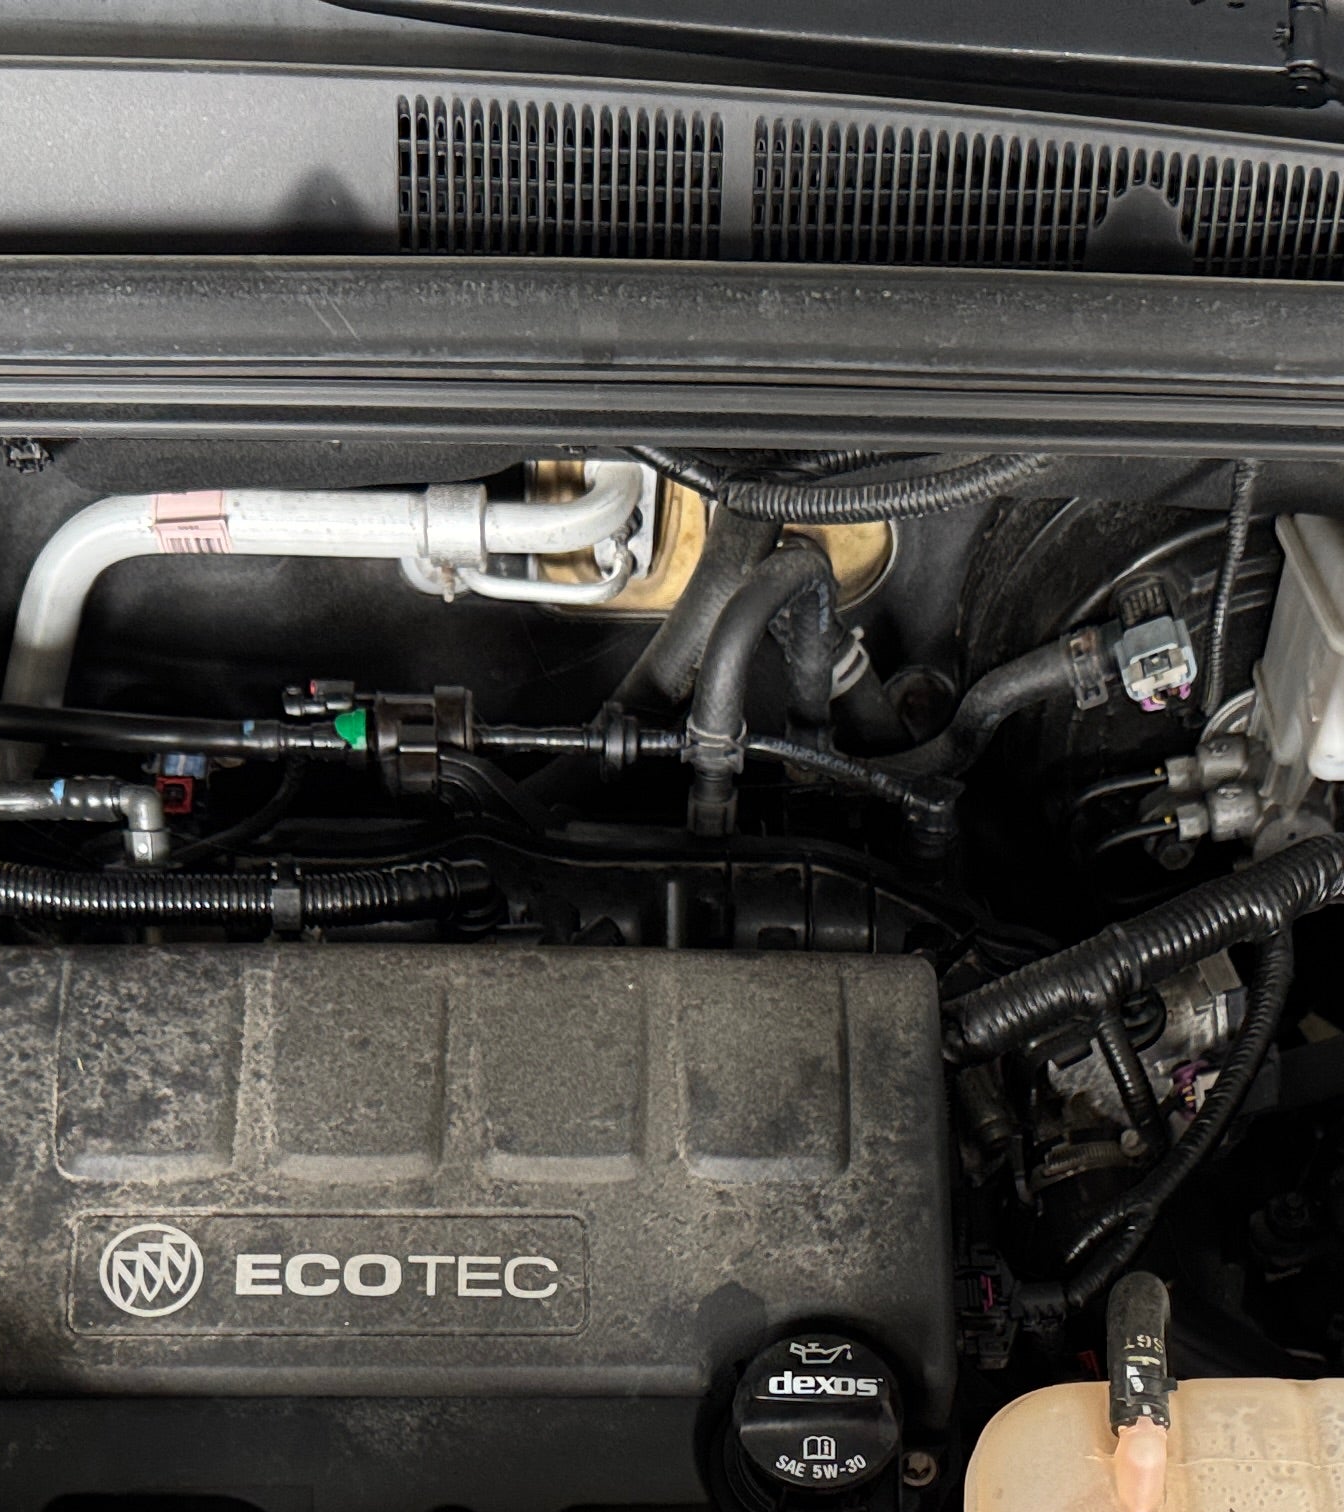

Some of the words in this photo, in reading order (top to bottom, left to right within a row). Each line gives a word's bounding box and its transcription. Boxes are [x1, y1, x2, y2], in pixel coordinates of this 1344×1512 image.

[235, 1253, 559, 1299] ECOTEC
[775, 1454, 807, 1478] SAE
[812, 1454, 867, 1479] 5W-30
